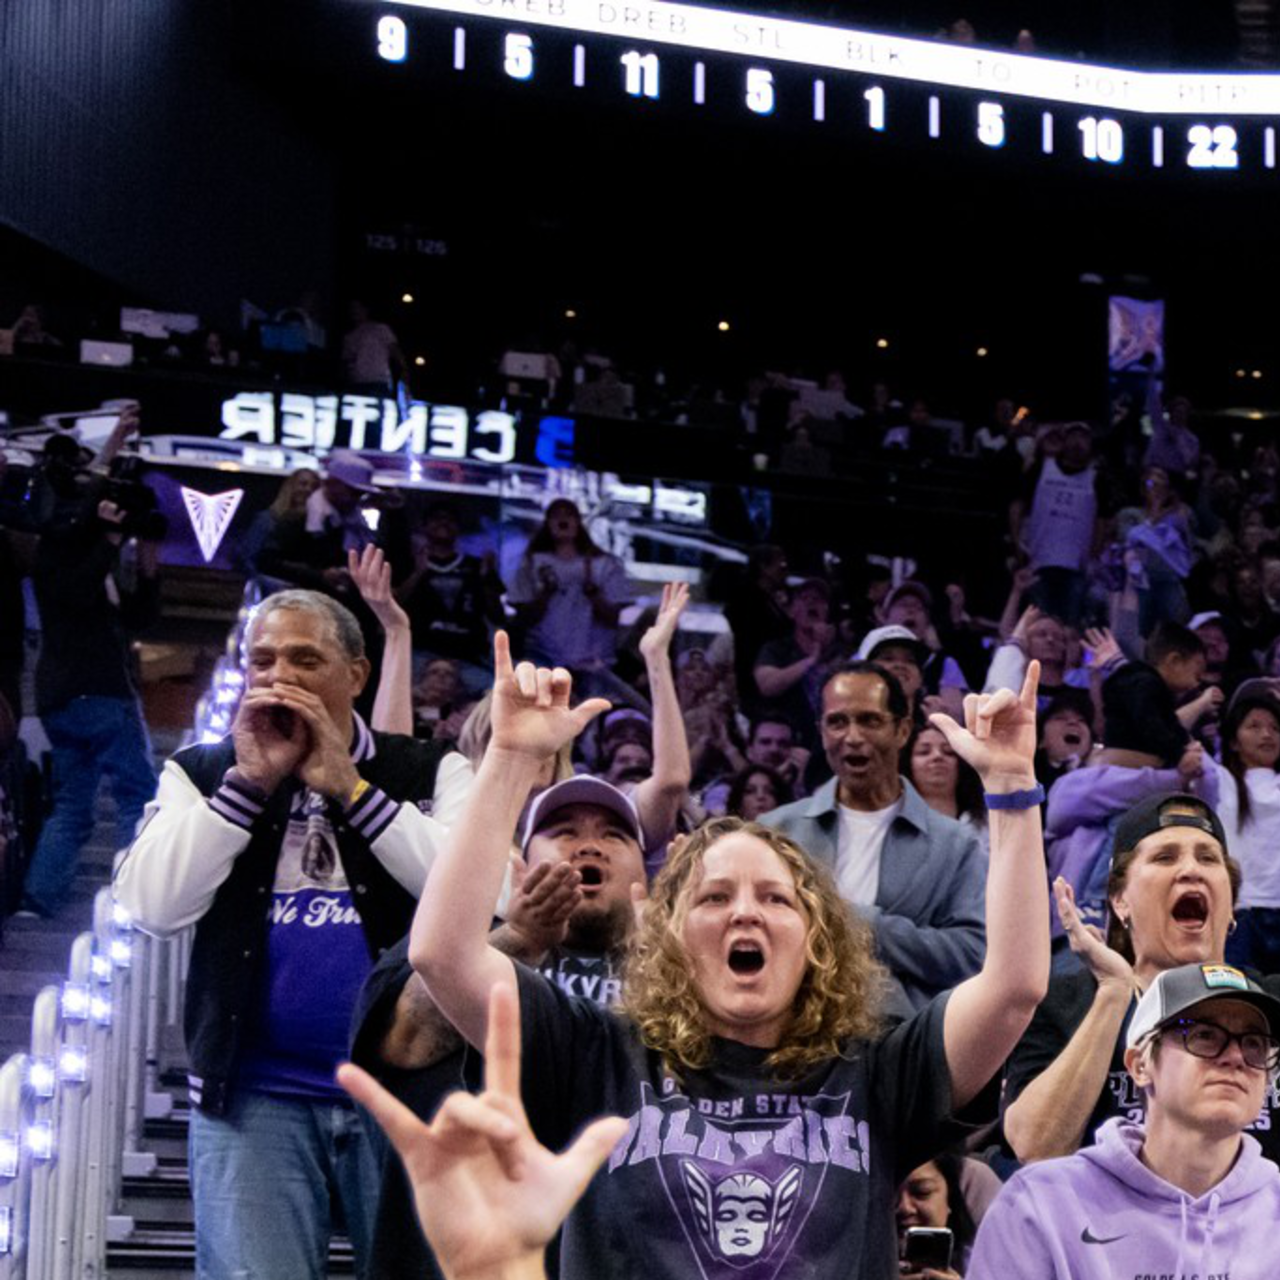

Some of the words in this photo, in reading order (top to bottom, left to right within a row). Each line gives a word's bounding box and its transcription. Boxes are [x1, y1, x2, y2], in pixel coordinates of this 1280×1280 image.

[377, 15, 406, 61] 9
[504, 33, 533, 78] 5
[620, 50, 658, 97] 11
[746, 68, 773, 113] 5
[864, 86, 884, 128] 1
[977, 102, 1004, 146] 5
[1078, 117, 1123, 162] 10
[1187, 125, 1238, 167] 22
[302, 895, 363, 927] Tru
